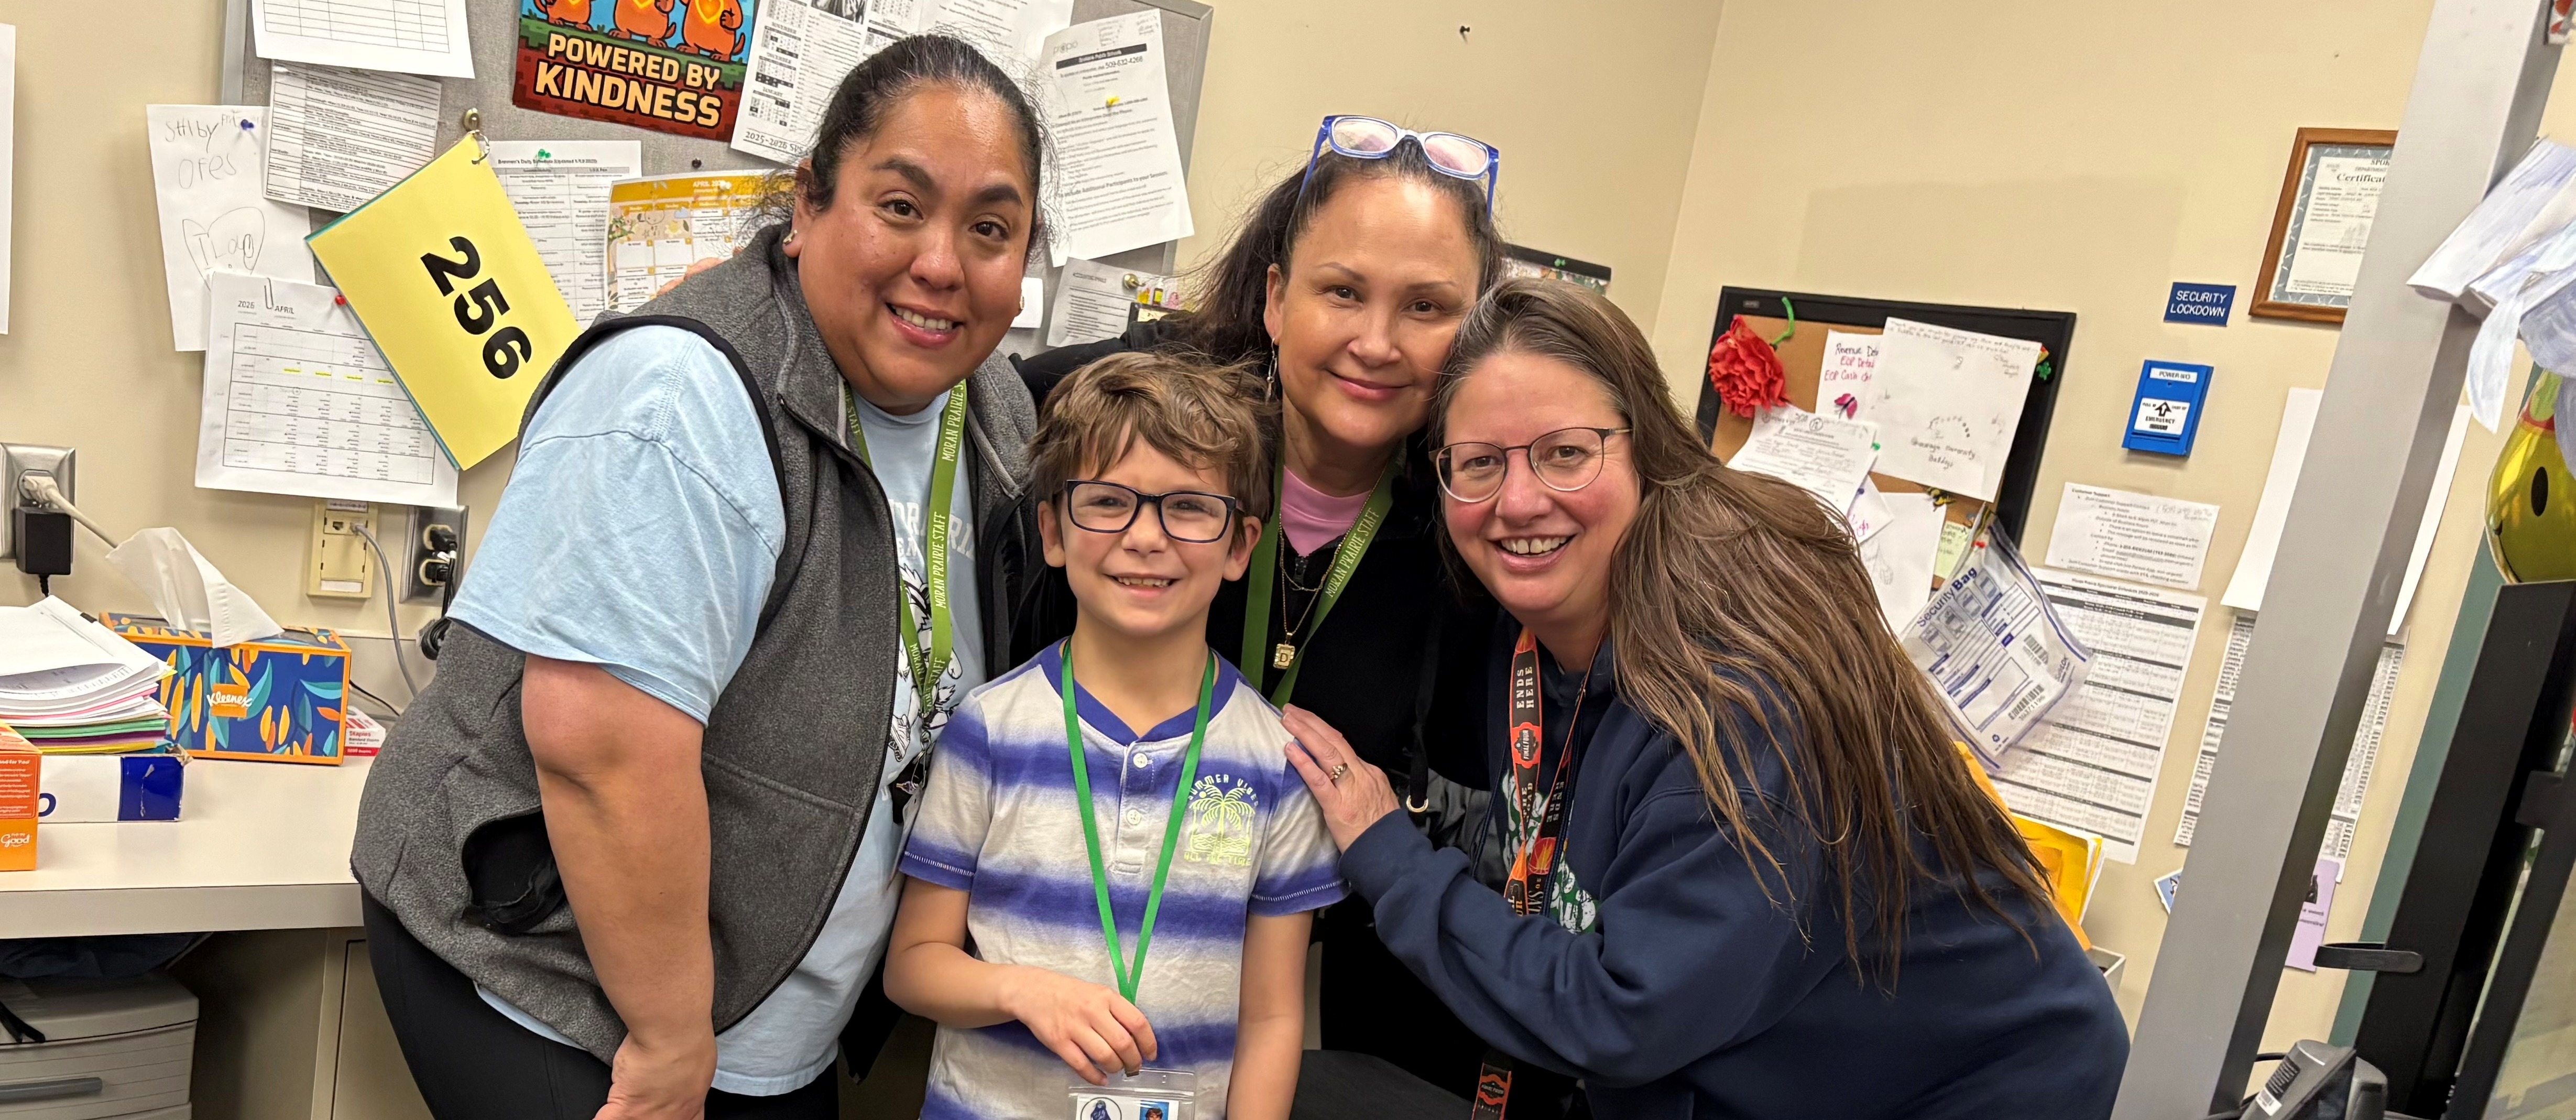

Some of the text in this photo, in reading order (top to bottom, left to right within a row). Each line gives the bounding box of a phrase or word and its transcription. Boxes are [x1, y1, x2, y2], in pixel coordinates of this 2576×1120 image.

[548, 33, 720, 90] POWERED BY
[536, 61, 721, 127] KINDNESS
[420, 236, 531, 379] 256
[2170, 303, 2225, 317] LOCKDOWN
[2176, 290, 2228, 303] SECURITY
[942, 390, 964, 462] MORAN PRAIRIE
[932, 512, 946, 608] MORAN PRAIRIE STAFF
[1325, 507, 1379, 599] MORAN PRAIRIE STAFF
[1917, 588, 1956, 627] Security
[1952, 568, 1977, 591] Bag
[910, 643, 925, 675] MORAN
[1280, 653, 1289, 662] D
[206, 691, 253, 708] Kleenex
[1516, 669, 1525, 709] ENDS
[1525, 666, 1534, 708] HERE
[1, 834, 30, 847] Good
[1184, 852, 1202, 862] ALL
[1228, 855, 1251, 866] TIME
